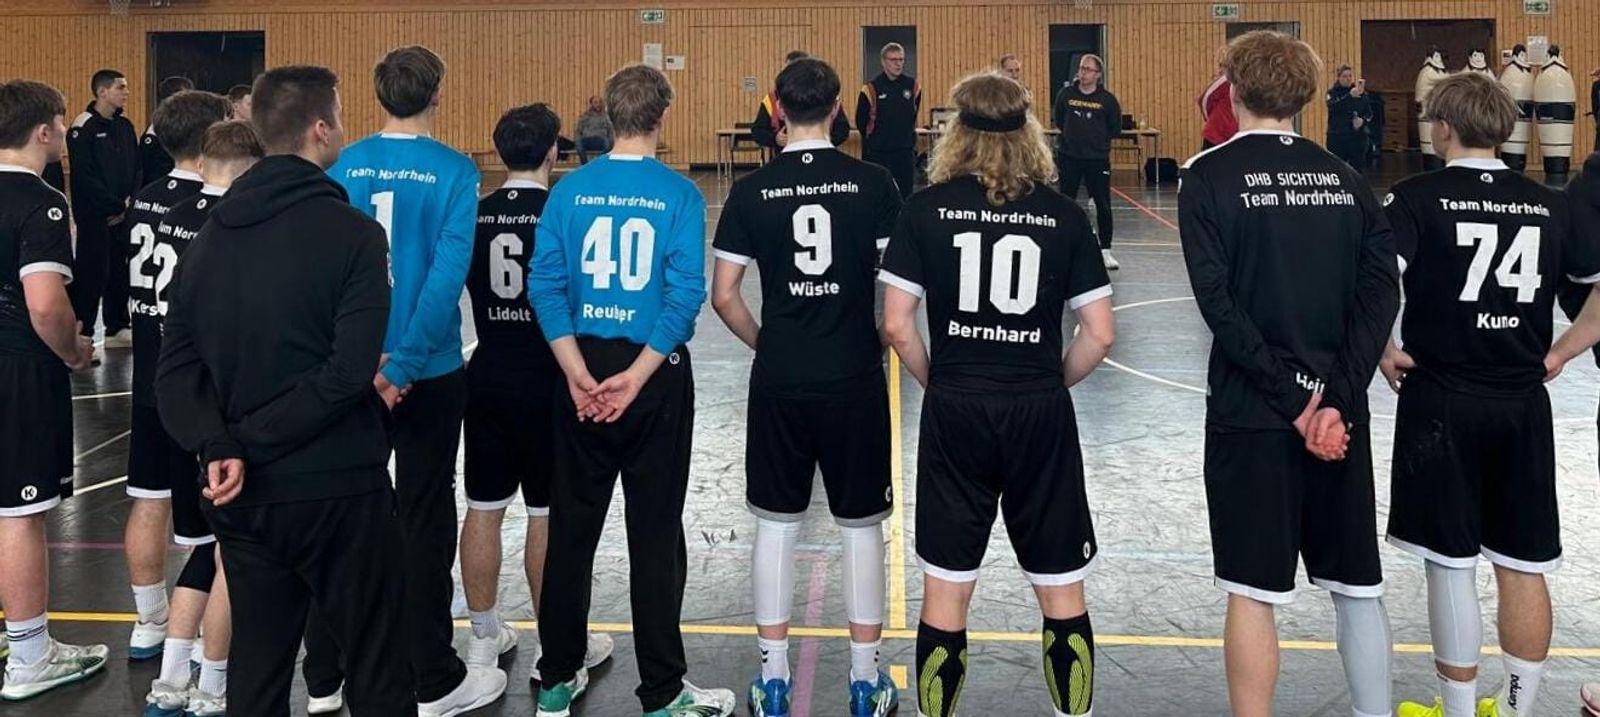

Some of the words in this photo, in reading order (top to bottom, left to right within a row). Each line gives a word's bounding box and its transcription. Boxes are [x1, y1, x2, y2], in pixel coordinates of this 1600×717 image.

[1244, 172, 1272, 187] DHB
[1277, 172, 1340, 187] SICHTUNG
[761, 187, 793, 200] Team
[796, 181, 859, 197] Nordrhein
[1240, 192, 1279, 208] Team
[1285, 190, 1355, 206] Nordrhein
[575, 195, 605, 206] Team
[608, 195, 666, 211] Nordrhein
[1440, 198, 1480, 211] Team
[938, 208, 977, 220] Team
[981, 210, 1056, 228] Nordrhein
[793, 204, 832, 276] 9
[581, 216, 656, 291] 40
[1455, 222, 1542, 303] 74
[490, 233, 524, 299] 6
[953, 231, 1041, 315] 10
[788, 281, 841, 297] Wüste
[488, 307, 531, 322] Lidolt
[948, 320, 1041, 344] Bernhard
